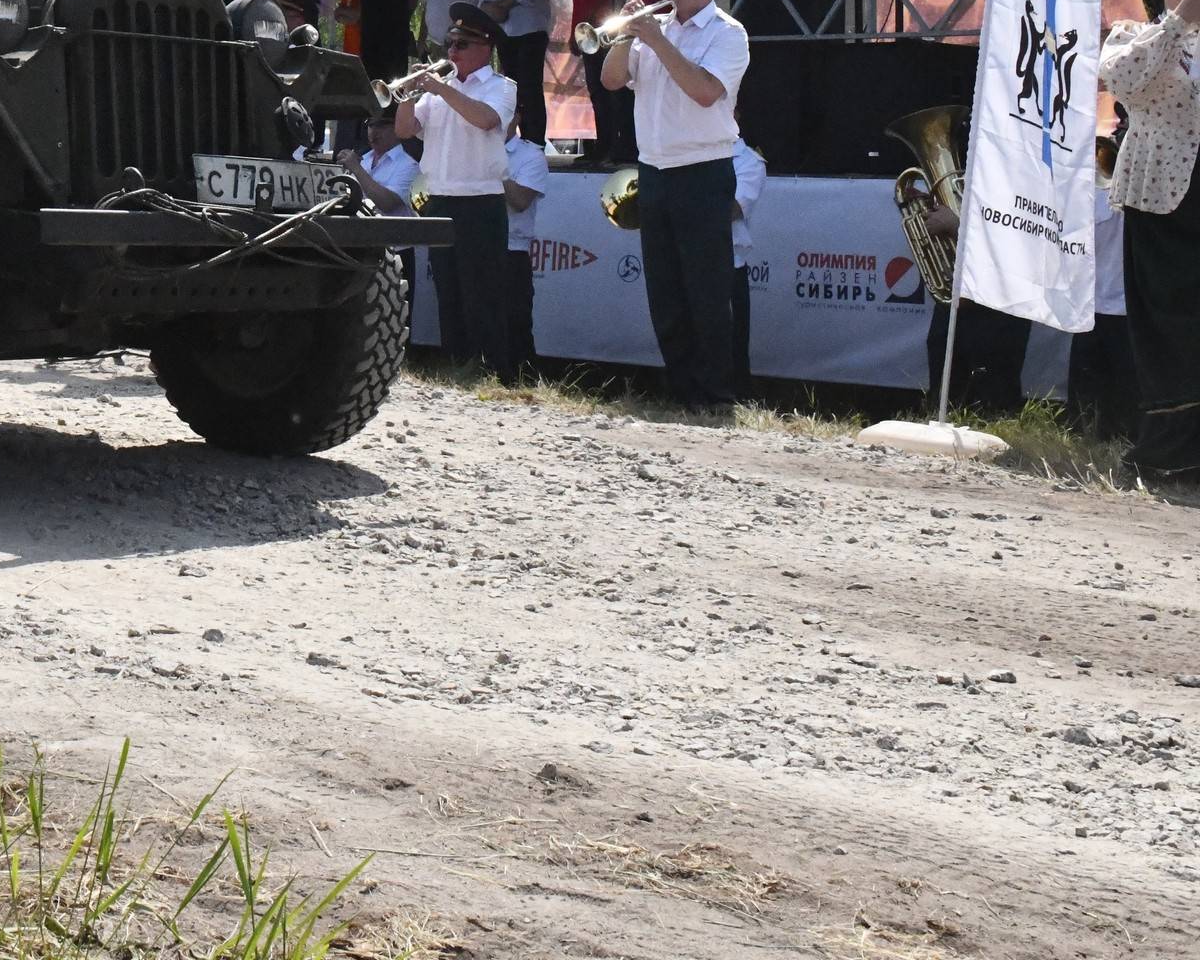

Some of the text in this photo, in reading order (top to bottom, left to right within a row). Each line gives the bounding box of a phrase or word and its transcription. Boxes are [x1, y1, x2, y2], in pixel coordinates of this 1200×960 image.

[797, 252, 877, 271] ОЛИМПИЯ
[795, 269, 877, 285] РАЙЗЕН
[795, 283, 876, 302] СИБИРЬ
